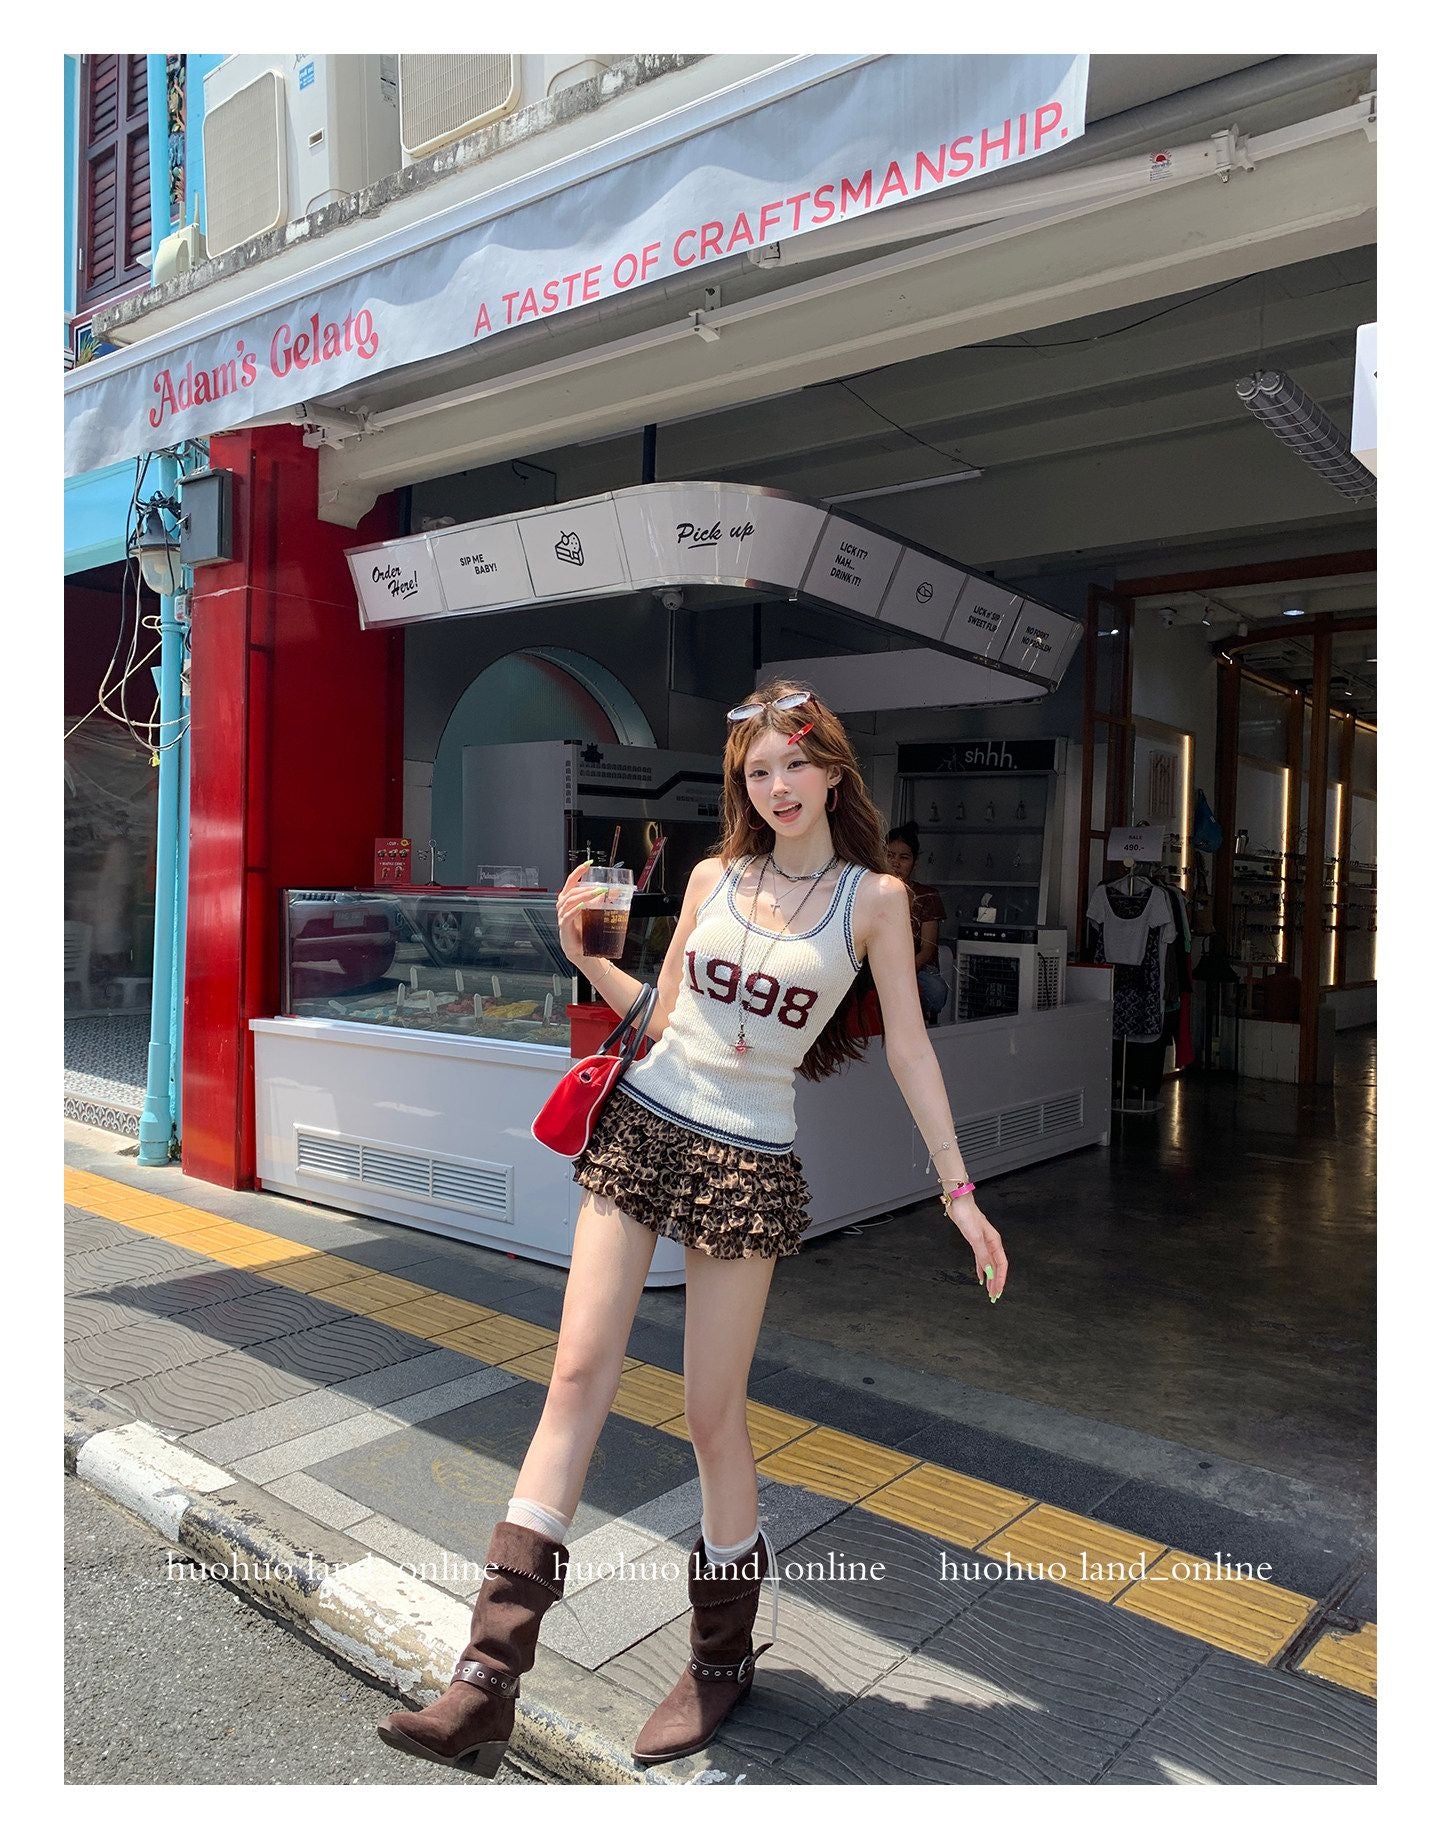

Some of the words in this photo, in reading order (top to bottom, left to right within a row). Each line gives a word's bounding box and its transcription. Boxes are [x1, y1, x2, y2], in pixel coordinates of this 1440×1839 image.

[474, 303, 492, 337] A
[502, 264, 602, 325] TASTE
[613, 241, 661, 289] OF
[673, 101, 1069, 267] CRAFTSMANSHIP.
[149, 340, 257, 428] Adam's
[269, 308, 379, 379] Gelato
[676, 521, 722, 545] Pick
[730, 522, 755, 541] up
[840, 541, 857, 556] LICK
[856, 549, 868, 560] IT?
[459, 556, 472, 567] SIP
[472, 554, 485, 564] ME
[474, 563, 498, 575] BABY!
[372, 564, 401, 583] Order
[830, 567, 852, 583] DRINK
[388, 571, 418, 598] Here!
[973, 605, 988, 617] LICK
[968, 615, 986, 629] SWEET
[1025, 625, 1035, 635] NO
[1021, 636, 1030, 645] NO
[964, 741, 1018, 770] shhh.
[685, 950, 819, 1030] 1998
